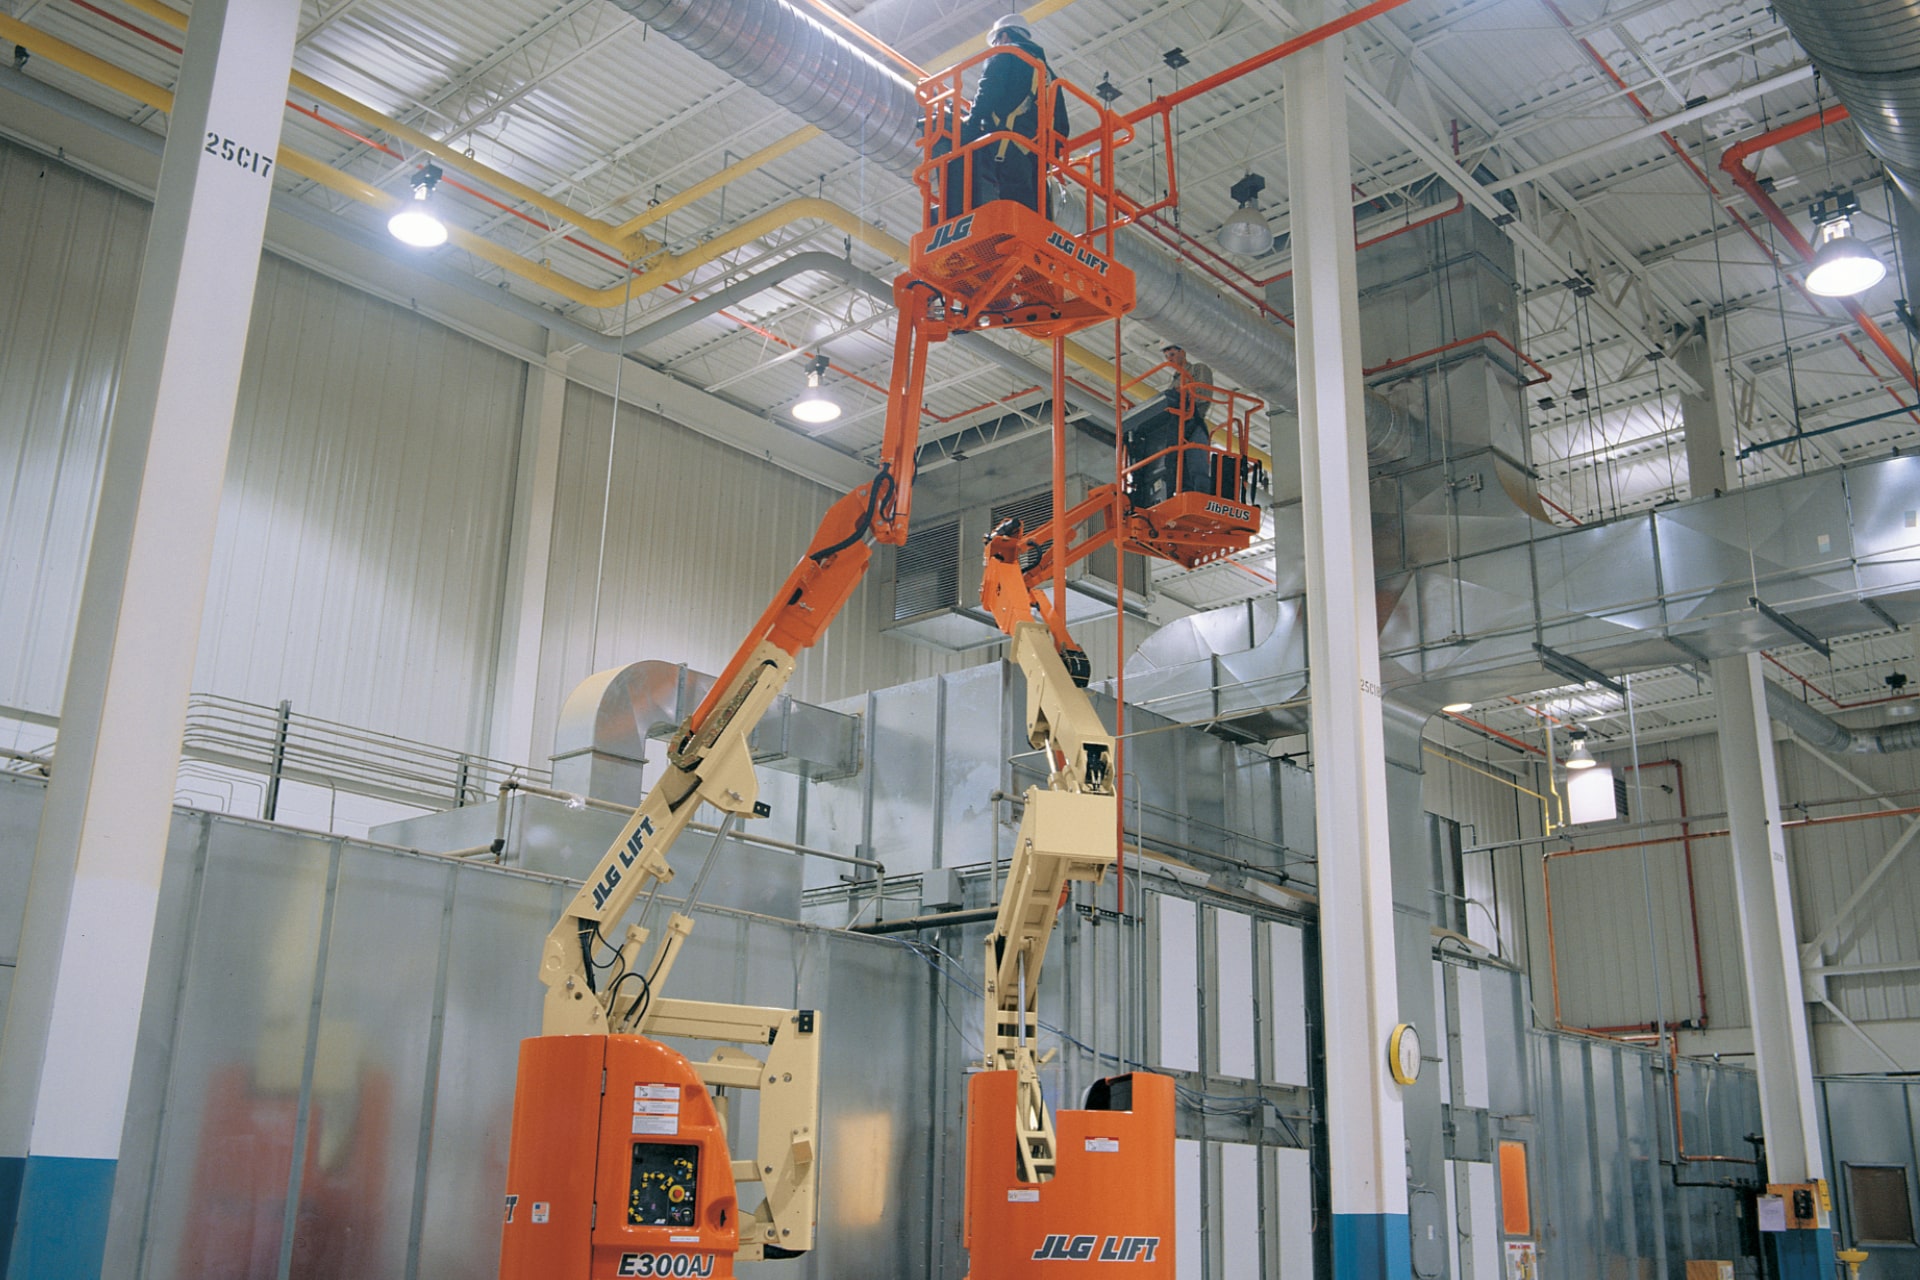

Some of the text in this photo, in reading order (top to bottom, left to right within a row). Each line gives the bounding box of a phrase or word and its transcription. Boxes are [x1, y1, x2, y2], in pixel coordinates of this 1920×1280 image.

[924, 213, 975, 254] JLG
[1046, 231, 1111, 277] JLG LIFT
[1205, 500, 1251, 522] JibPLUS
[592, 816, 656, 912] JLG LIFT
[617, 1252, 715, 1278] E300AJ
[1031, 1234, 1160, 1262] JLG LIFT
